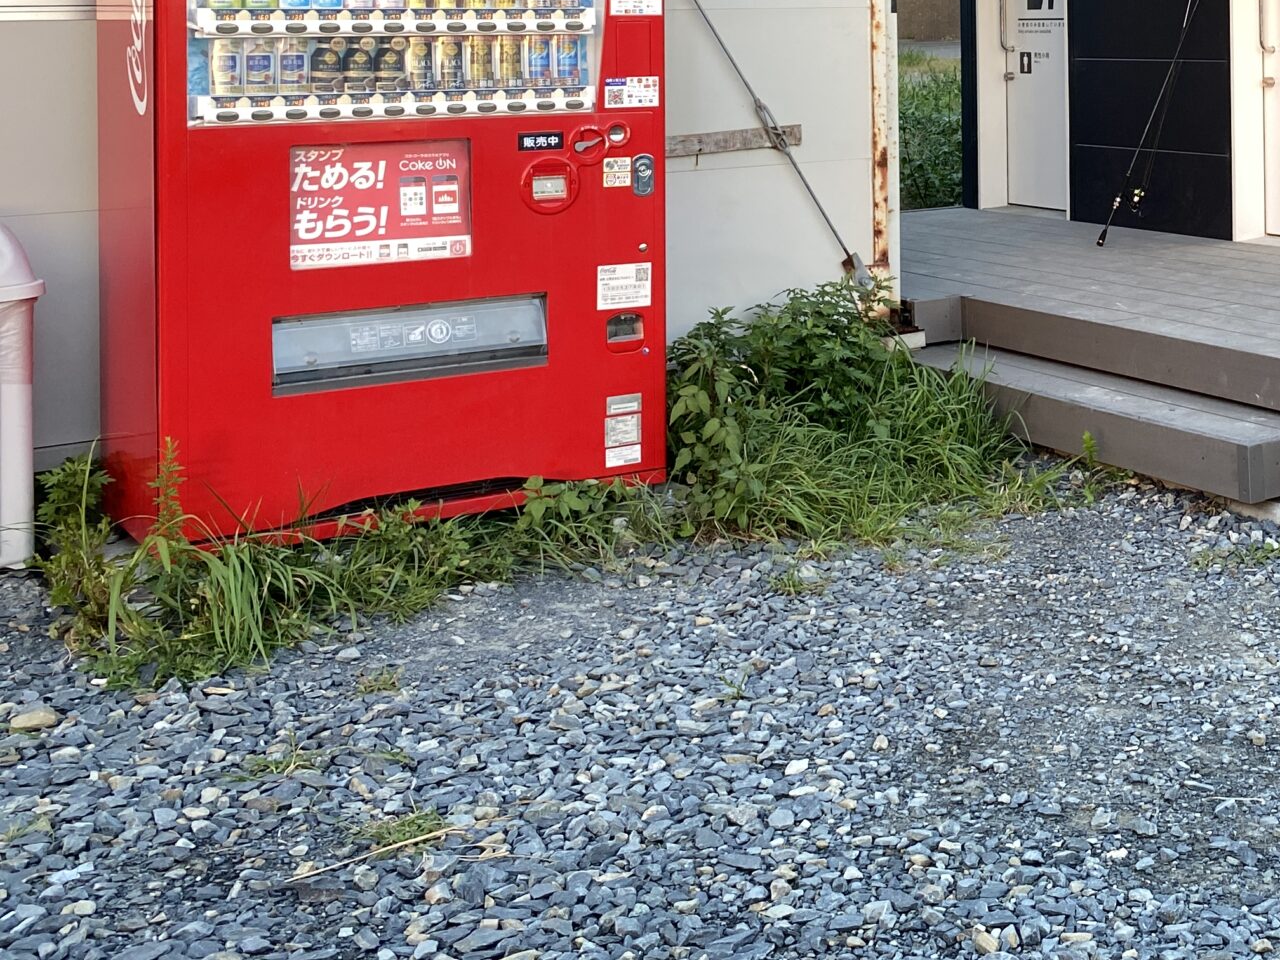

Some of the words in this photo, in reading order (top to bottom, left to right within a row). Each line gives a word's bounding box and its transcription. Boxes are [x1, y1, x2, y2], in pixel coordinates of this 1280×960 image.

[523, 136, 559, 148] 販売中
[294, 149, 345, 162] スタンプ
[399, 160, 433, 172] Coke
[291, 160, 387, 193] ためる!
[296, 196, 344, 210] ドリンク
[293, 206, 389, 240] もらう!
